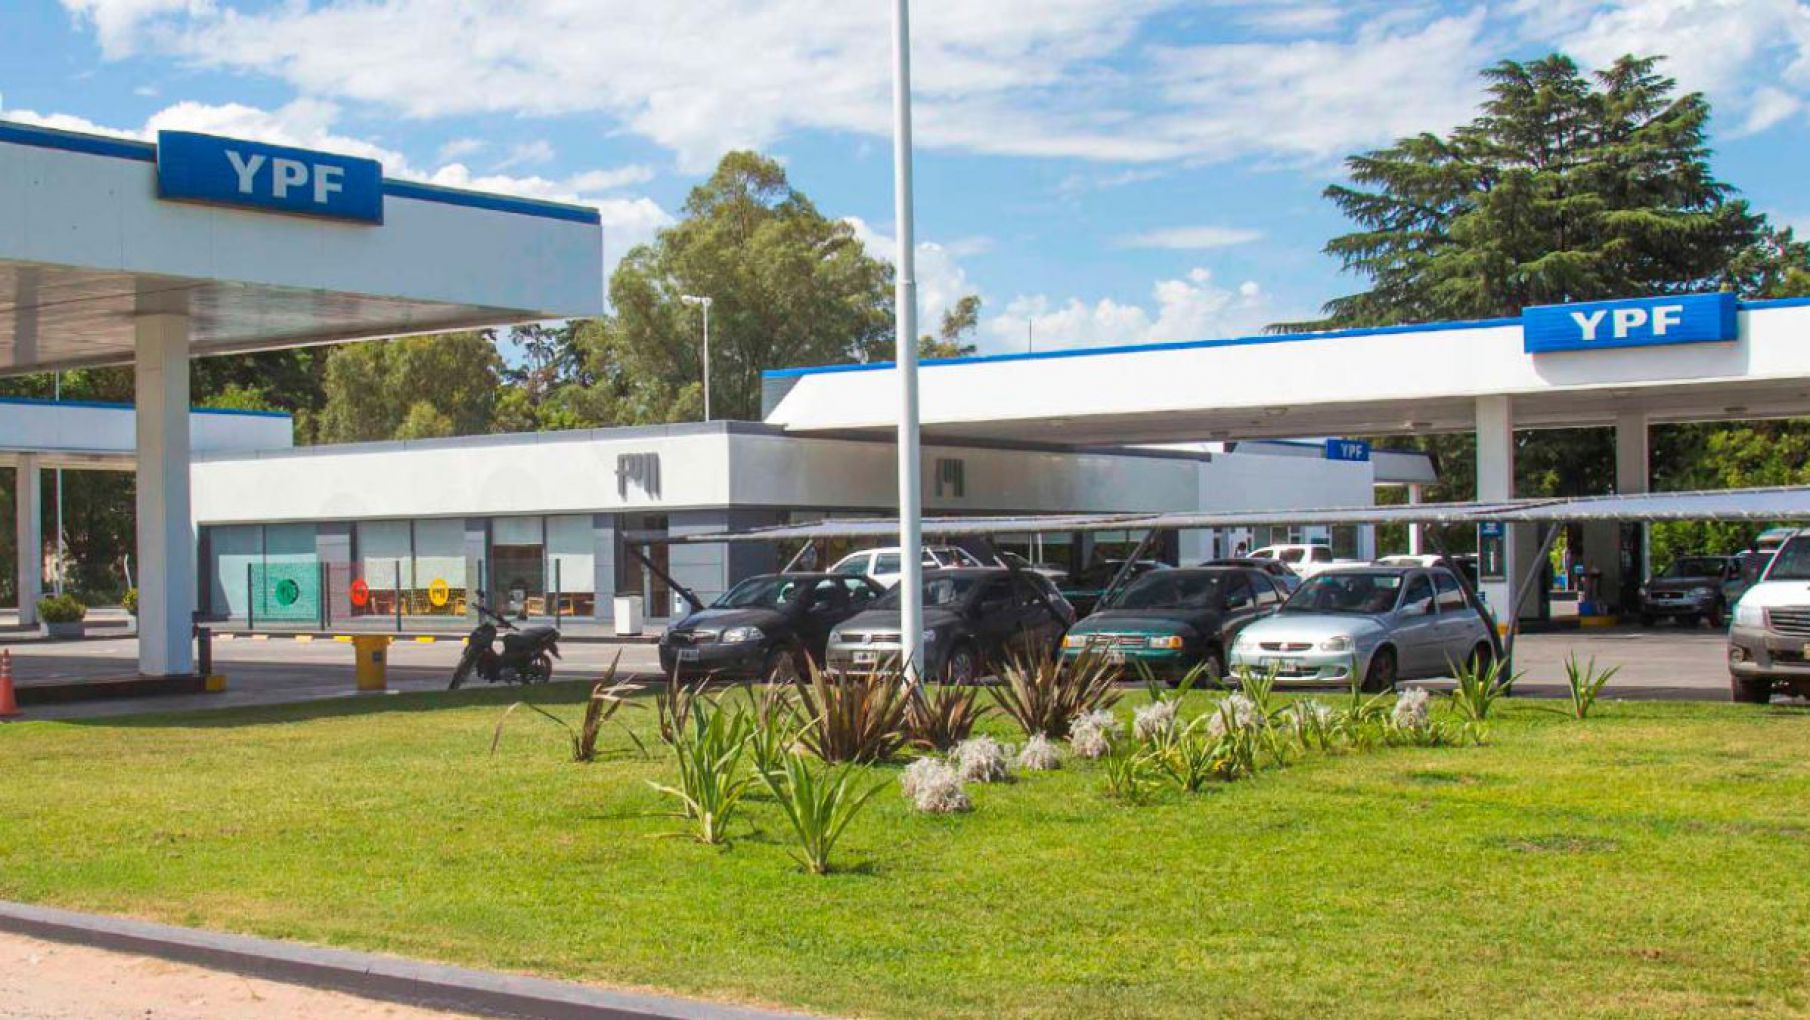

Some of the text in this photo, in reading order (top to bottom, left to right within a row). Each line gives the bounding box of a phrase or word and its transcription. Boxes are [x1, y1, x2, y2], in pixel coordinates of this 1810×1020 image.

[226, 151, 344, 203] YPF
[1571, 304, 1683, 340] YPF
[1342, 444, 1363, 458] YPF
